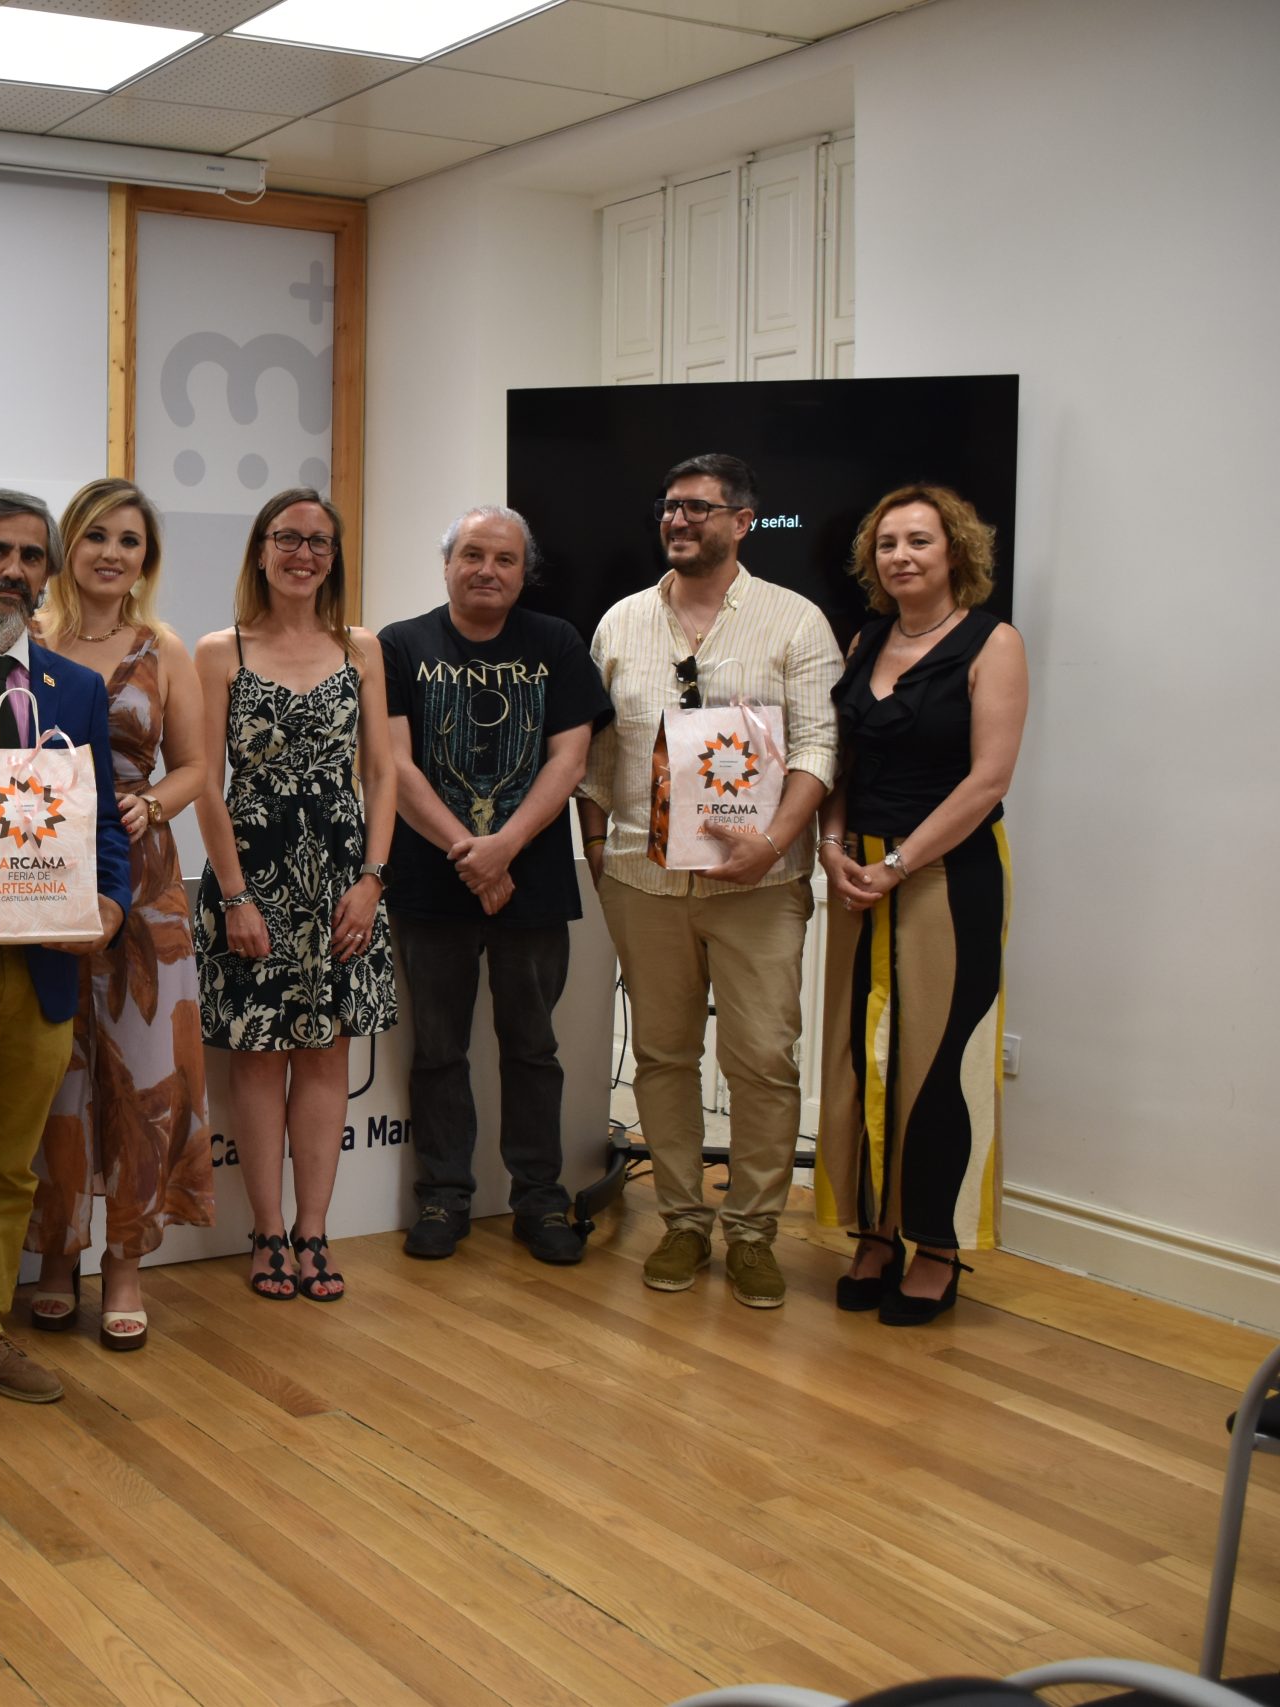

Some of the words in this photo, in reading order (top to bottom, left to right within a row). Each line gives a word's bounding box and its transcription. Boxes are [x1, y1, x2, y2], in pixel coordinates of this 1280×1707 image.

[761, 515, 803, 529] señal.
[417, 659, 549, 689] MYNTRA
[697, 804, 758, 815] FARCAMA
[709, 816, 732, 824] FERIA
[733, 816, 745, 824] DE
[8, 871, 35, 881] FERIA
[37, 871, 51, 881] DE
